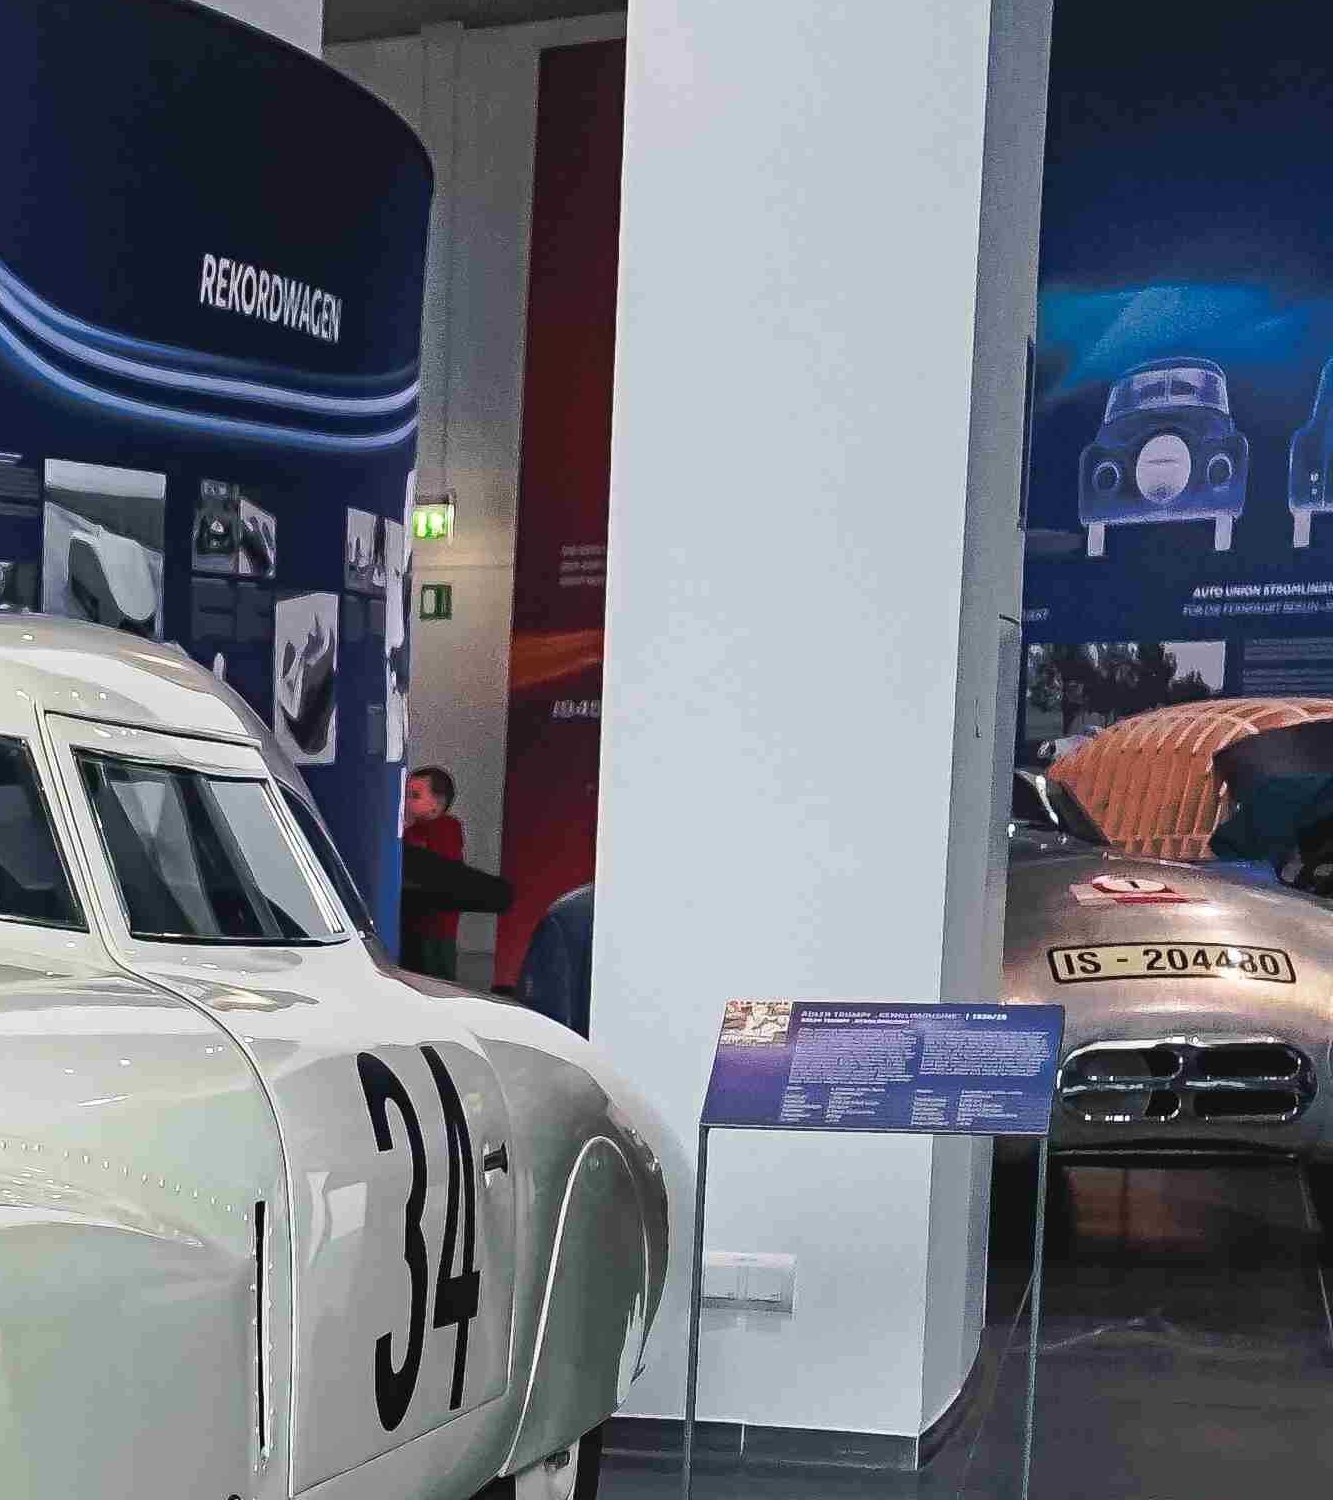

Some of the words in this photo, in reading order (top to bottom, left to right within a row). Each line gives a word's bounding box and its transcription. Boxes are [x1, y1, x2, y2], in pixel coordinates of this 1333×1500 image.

[199, 253, 343, 344] REKORDWAGEN
[1063, 951, 1102, 976] IS
[1142, 948, 1281, 977] 204480
[356, 1045, 481, 1432] 34
